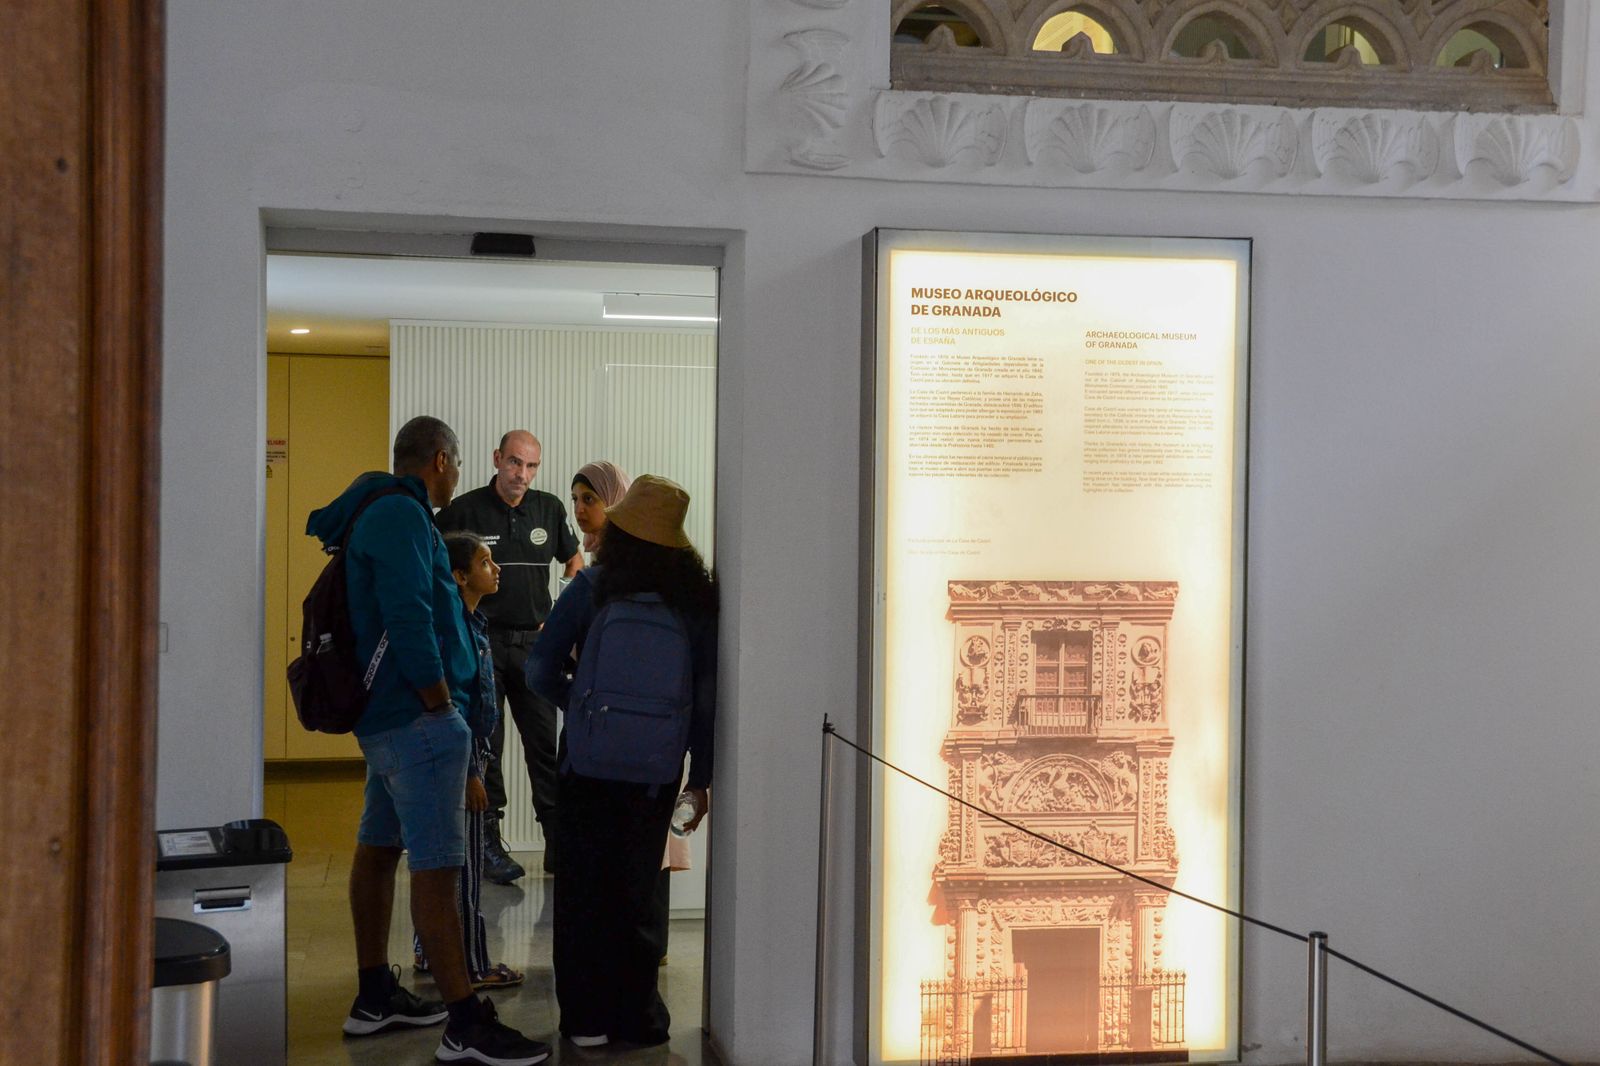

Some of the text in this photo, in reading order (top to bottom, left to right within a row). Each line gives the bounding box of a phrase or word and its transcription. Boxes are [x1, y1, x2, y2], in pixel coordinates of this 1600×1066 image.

[911, 287, 1078, 303] MUSEO ARQUEOLÓGICO
[911, 304, 1002, 318] DE GRANADA
[910, 326, 922, 335] DE
[923, 327, 941, 335] LOS
[961, 328, 1006, 337] ANTIGUOS
[1085, 330, 1197, 341] ARCHAEOLOGICAL MUSEUM
[910, 336, 957, 346] DE ESPAÑA
[1085, 340, 1138, 350] OF GRANADA
